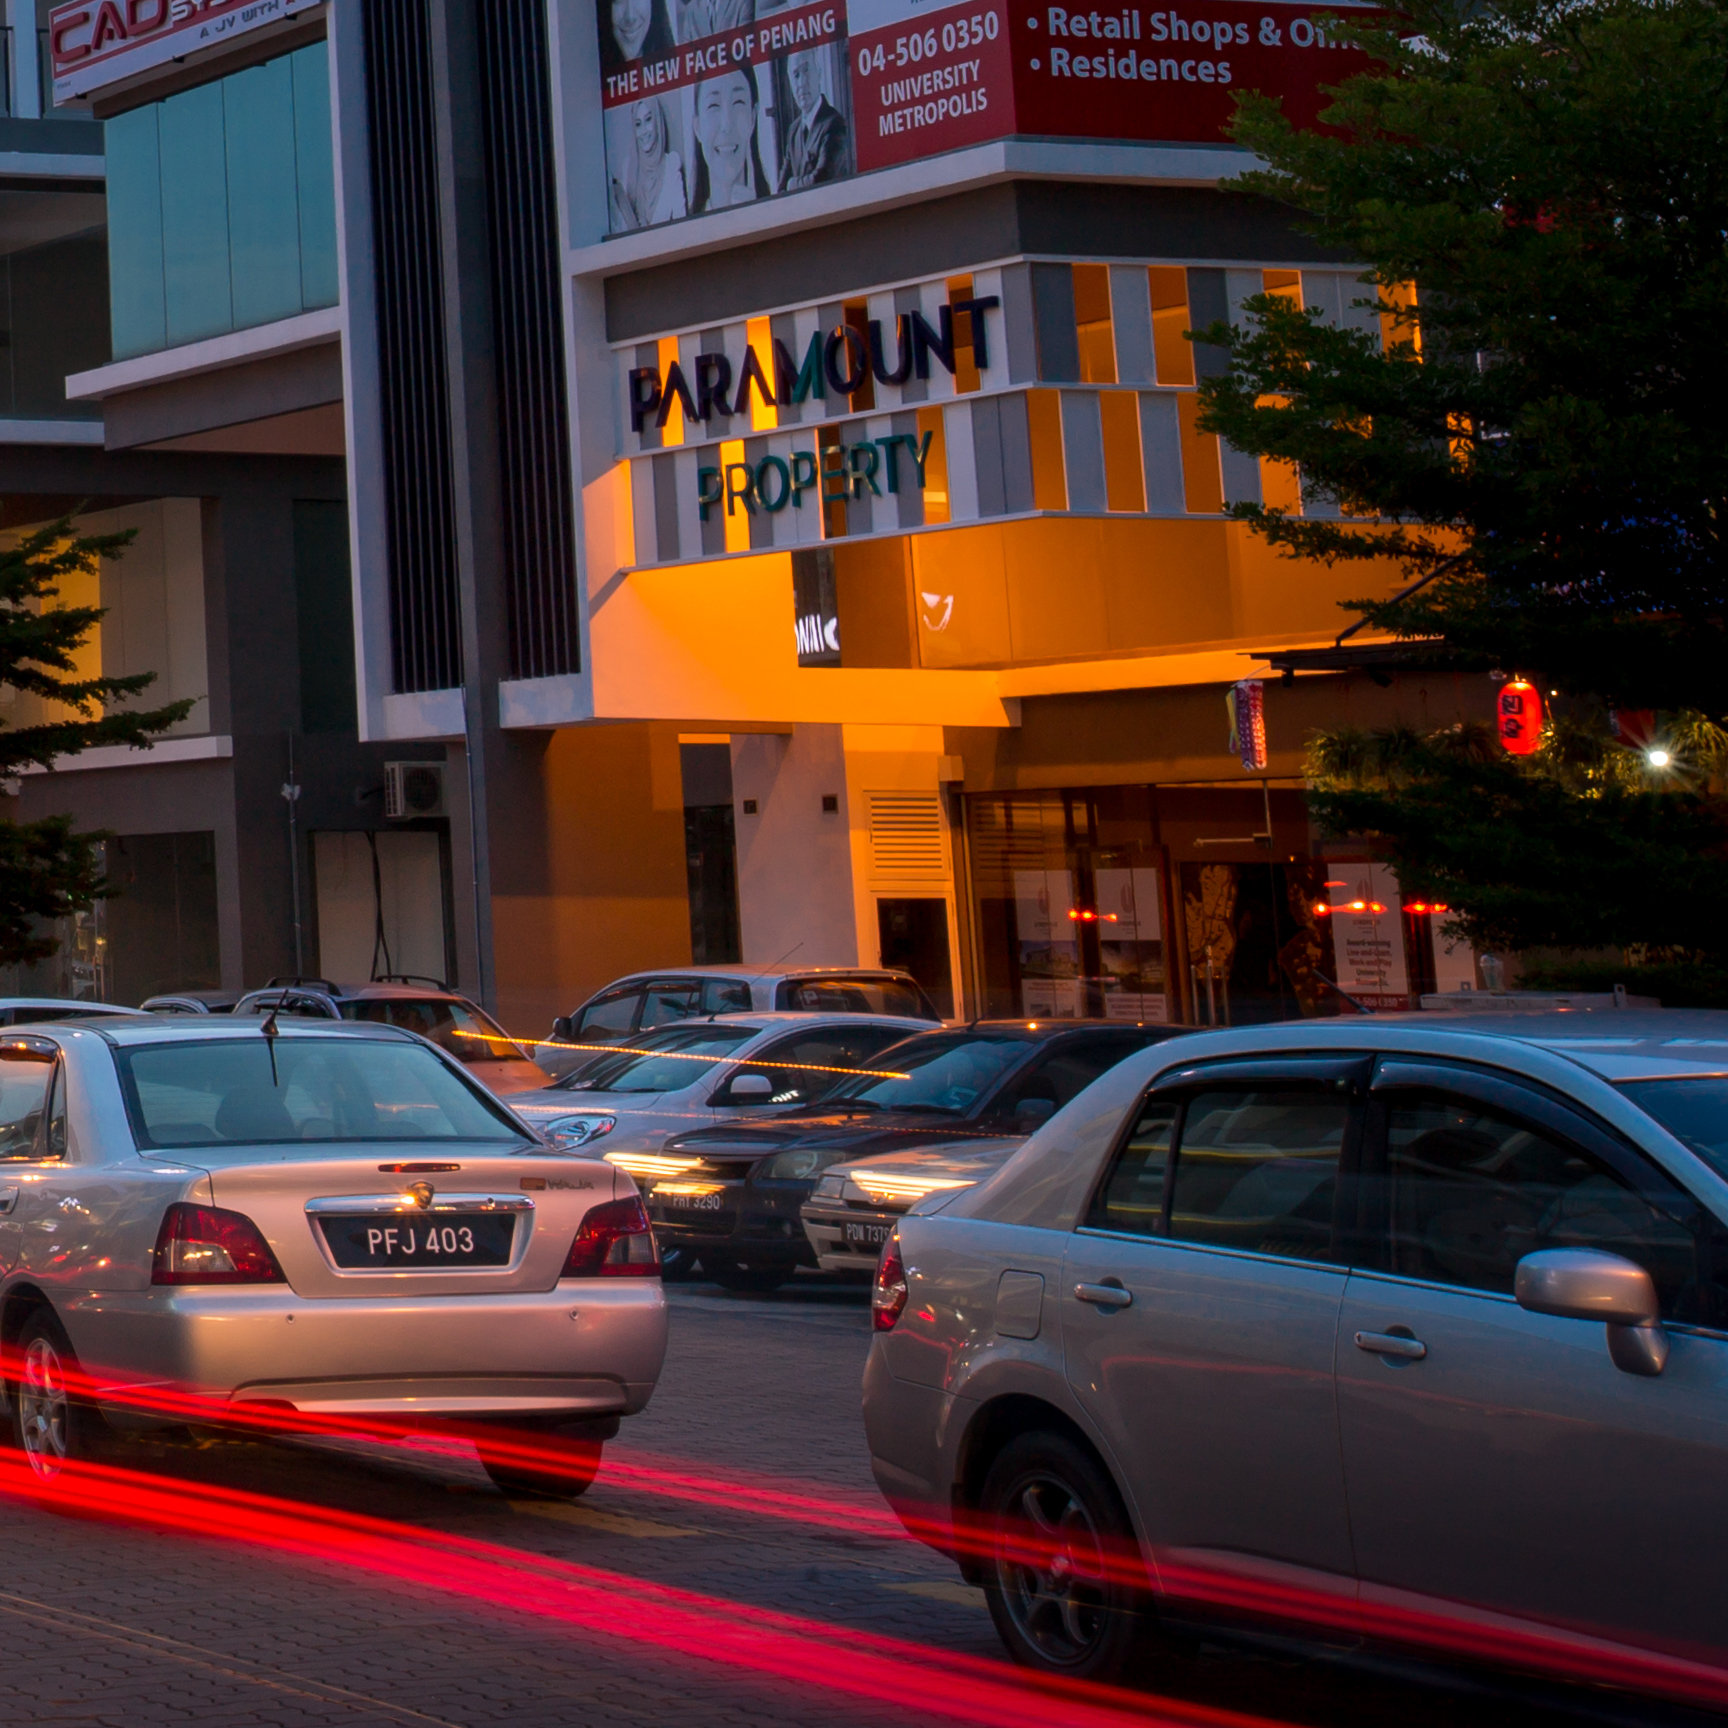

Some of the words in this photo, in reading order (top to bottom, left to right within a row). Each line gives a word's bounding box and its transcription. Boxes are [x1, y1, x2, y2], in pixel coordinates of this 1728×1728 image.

[200, 28, 209, 39] A
[215, 16, 236, 33] JV
[241, 0, 279, 22] WITH
[858, 28, 937, 77] 04-506
[942, 10, 1000, 53] 0350
[1048, 7, 1141, 40] Retail
[1150, 11, 1250, 51] Shops
[1258, 17, 1283, 47] &
[606, 69, 638, 99] THE
[643, 56, 680, 89] NEW
[685, 42, 728, 76] FACE
[731, 34, 755, 62] OF
[760, 9, 836, 54] PENANG
[1050, 47, 1232, 84] Residences
[880, 59, 981, 107] UNIVERSITY
[879, 87, 988, 137] METROPOLIS
[628, 295, 1000, 433] PARAMOUNT
[697, 430, 933, 522] PROPERTY
[367, 1227, 416, 1255] PFJ
[425, 1227, 474, 1254] 403
